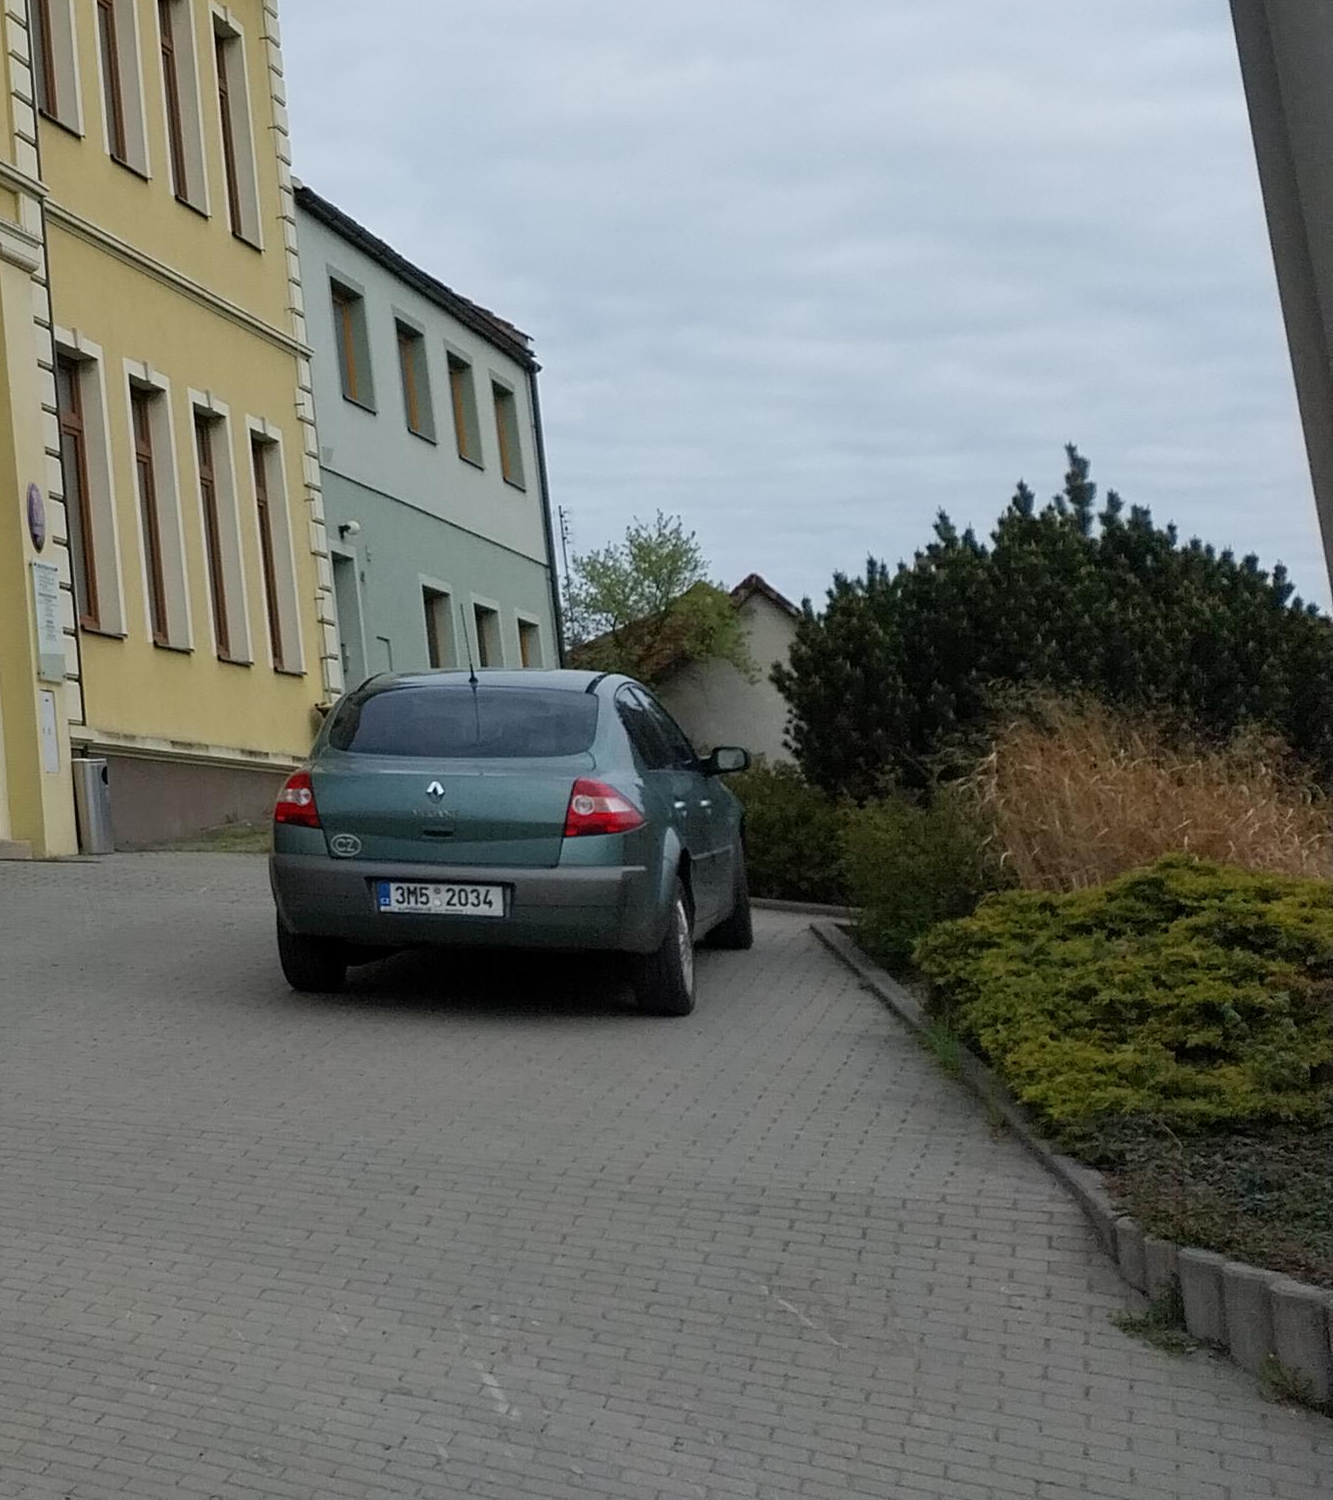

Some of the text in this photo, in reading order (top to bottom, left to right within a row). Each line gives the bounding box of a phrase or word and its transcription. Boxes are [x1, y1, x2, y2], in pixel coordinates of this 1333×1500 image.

[335, 838, 355, 852] CZ
[395, 886, 494, 908] 3M5 2034
